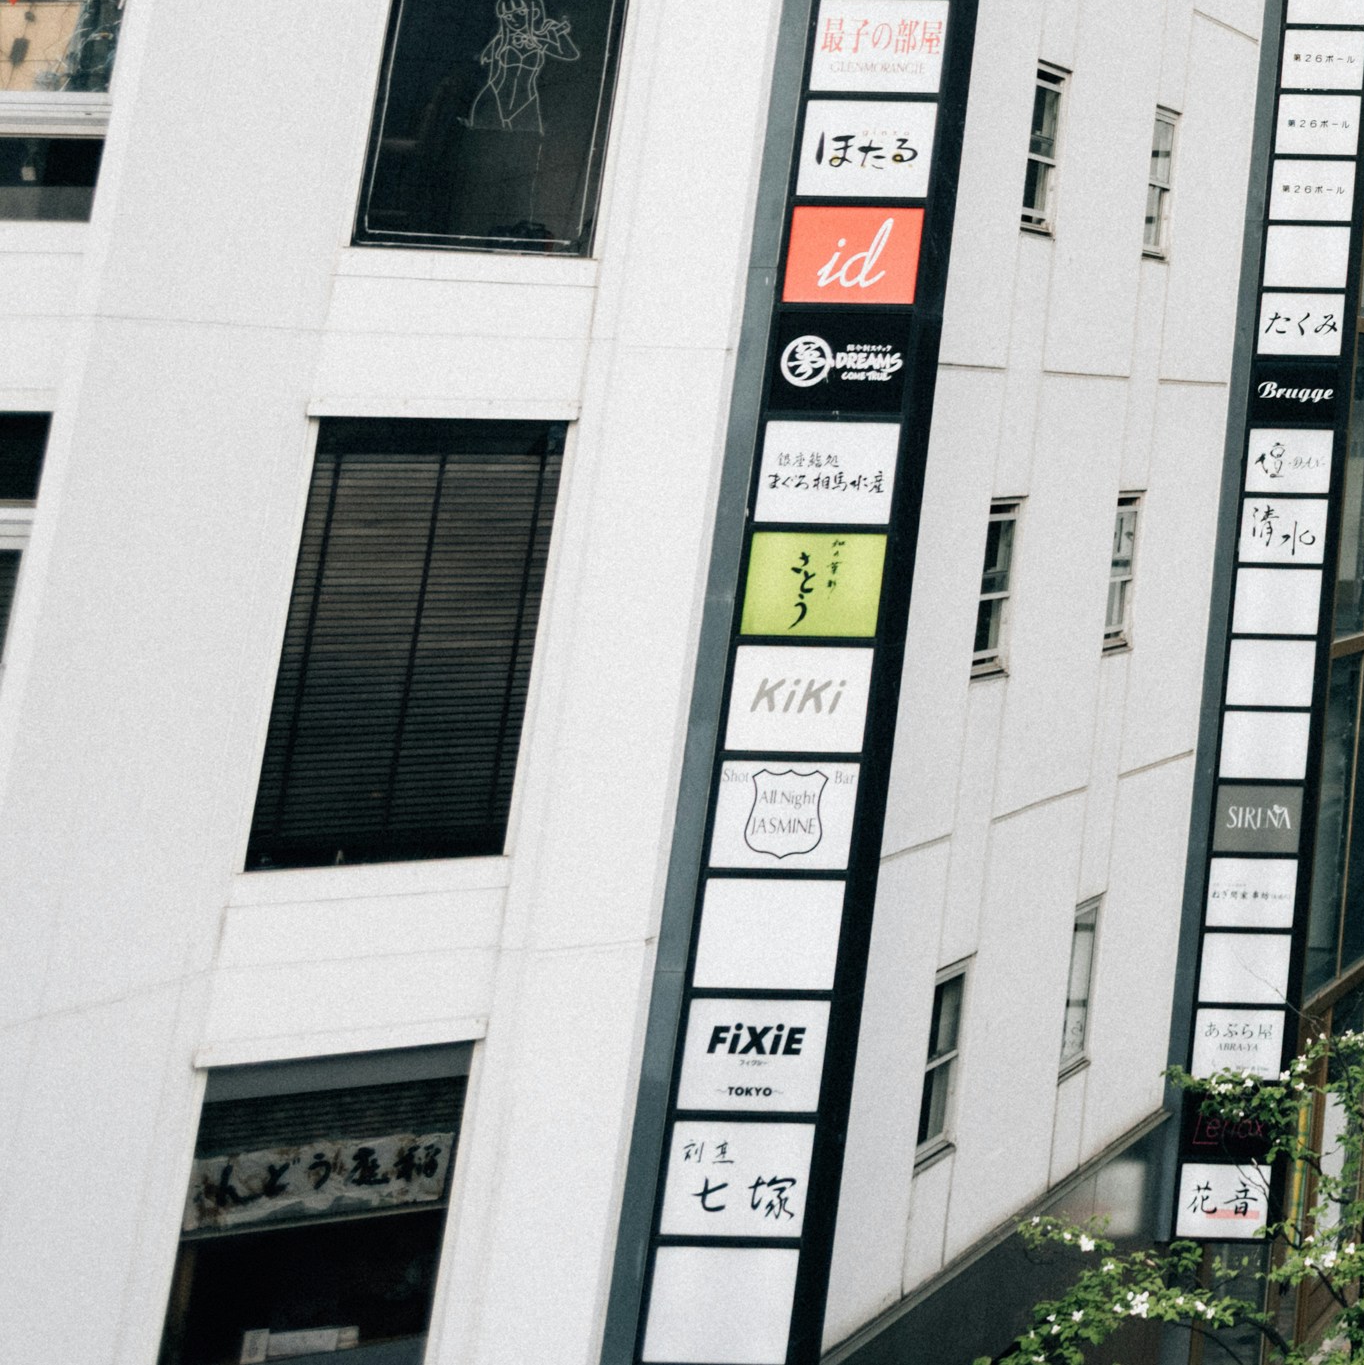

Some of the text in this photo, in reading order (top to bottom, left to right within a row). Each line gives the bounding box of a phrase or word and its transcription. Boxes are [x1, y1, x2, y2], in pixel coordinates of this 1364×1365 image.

[815, 131, 919, 170] ほたる
[816, 217, 895, 289] id
[1264, 311, 1339, 337] たくみ
[834, 351, 904, 373] DREAMS
[840, 370, 893, 382] COME TRUE
[1257, 380, 1334, 404] Brugge
[788, 551, 817, 630] さとう
[750, 677, 847, 715] KiKi
[722, 768, 856, 785] Shot Bar
[758, 790, 816, 810] All Night
[751, 817, 817, 836] JASMINE
[727, 1086, 773, 1097] TOKYO
